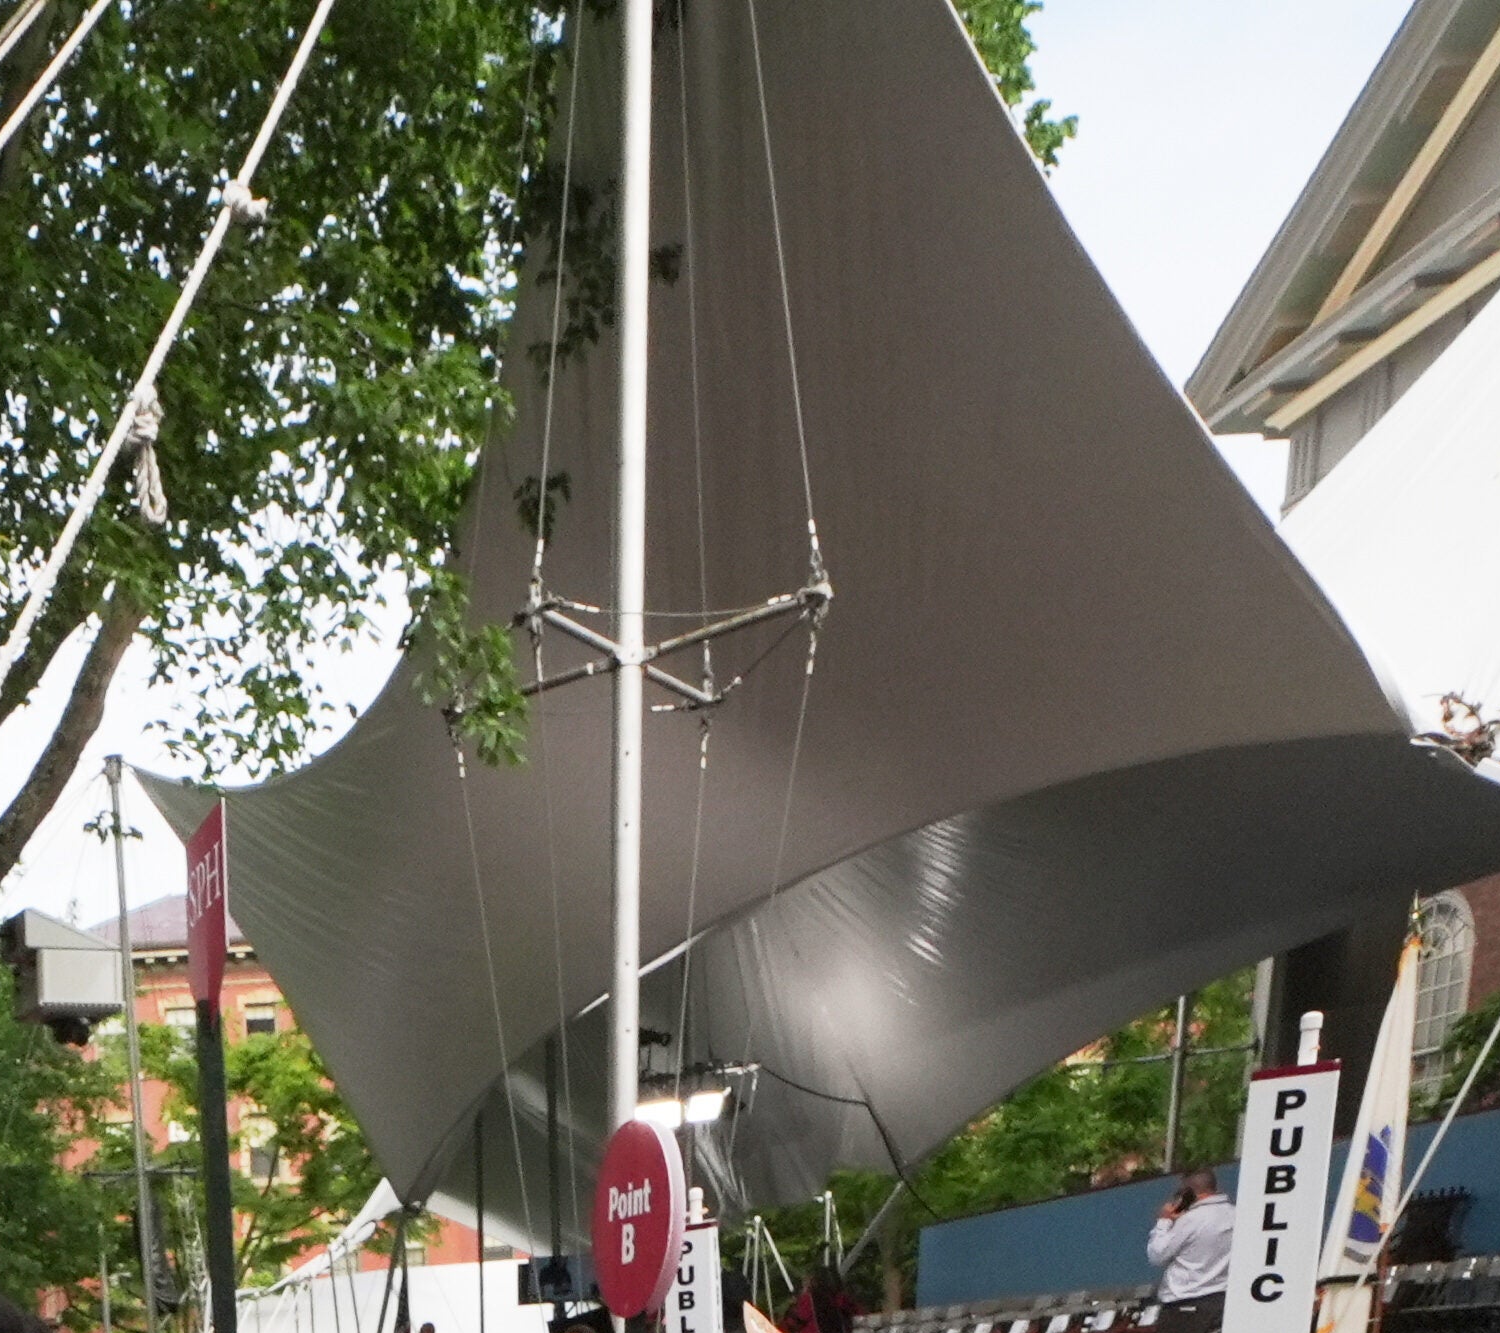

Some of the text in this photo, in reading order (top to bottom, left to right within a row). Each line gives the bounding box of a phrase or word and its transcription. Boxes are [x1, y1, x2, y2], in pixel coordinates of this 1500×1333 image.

[608, 1178, 651, 1223] Point
[1249, 1087, 1307, 1304] PUBLIC
[620, 1222, 635, 1266] B
